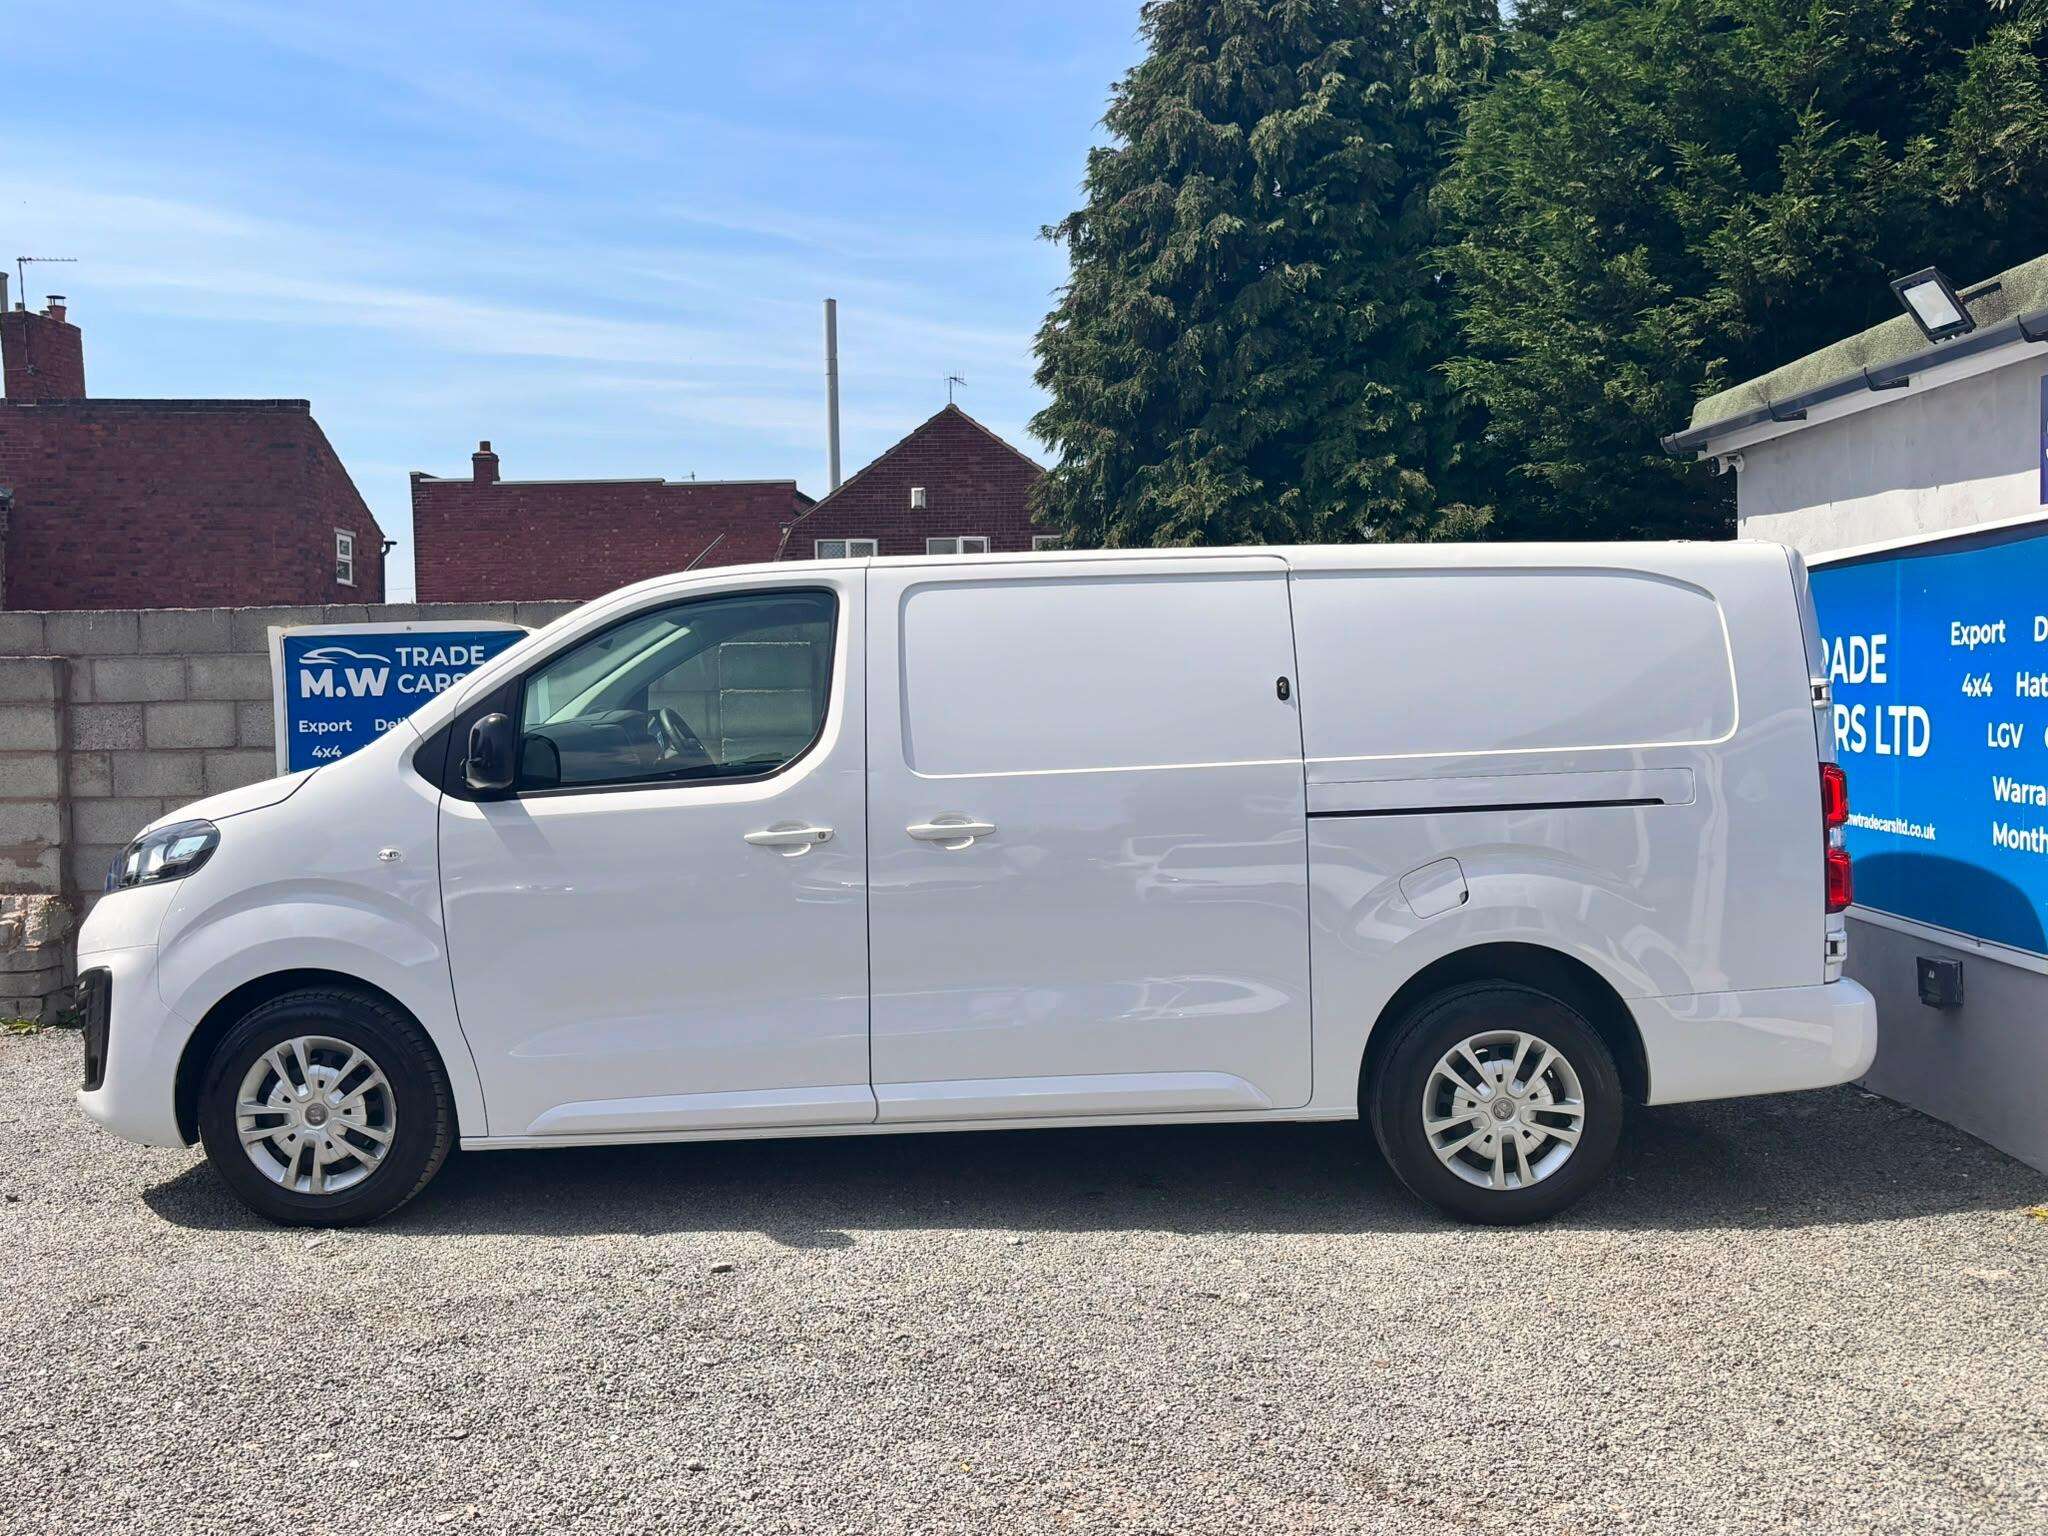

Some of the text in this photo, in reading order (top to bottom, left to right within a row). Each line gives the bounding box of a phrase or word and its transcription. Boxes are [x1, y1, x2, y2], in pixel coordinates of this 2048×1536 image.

[1951, 619, 2006, 651] Export
[395, 645, 485, 667] TRADE
[301, 667, 390, 698] M.W
[1961, 672, 1993, 697] 4x4
[298, 717, 406, 736] Export De
[1875, 705, 1931, 758] LTD
[1987, 722, 2024, 749] LGV
[311, 745, 343, 758] 4x4
[1992, 775, 2048, 807] Warra
[1992, 821, 2048, 855] Month
